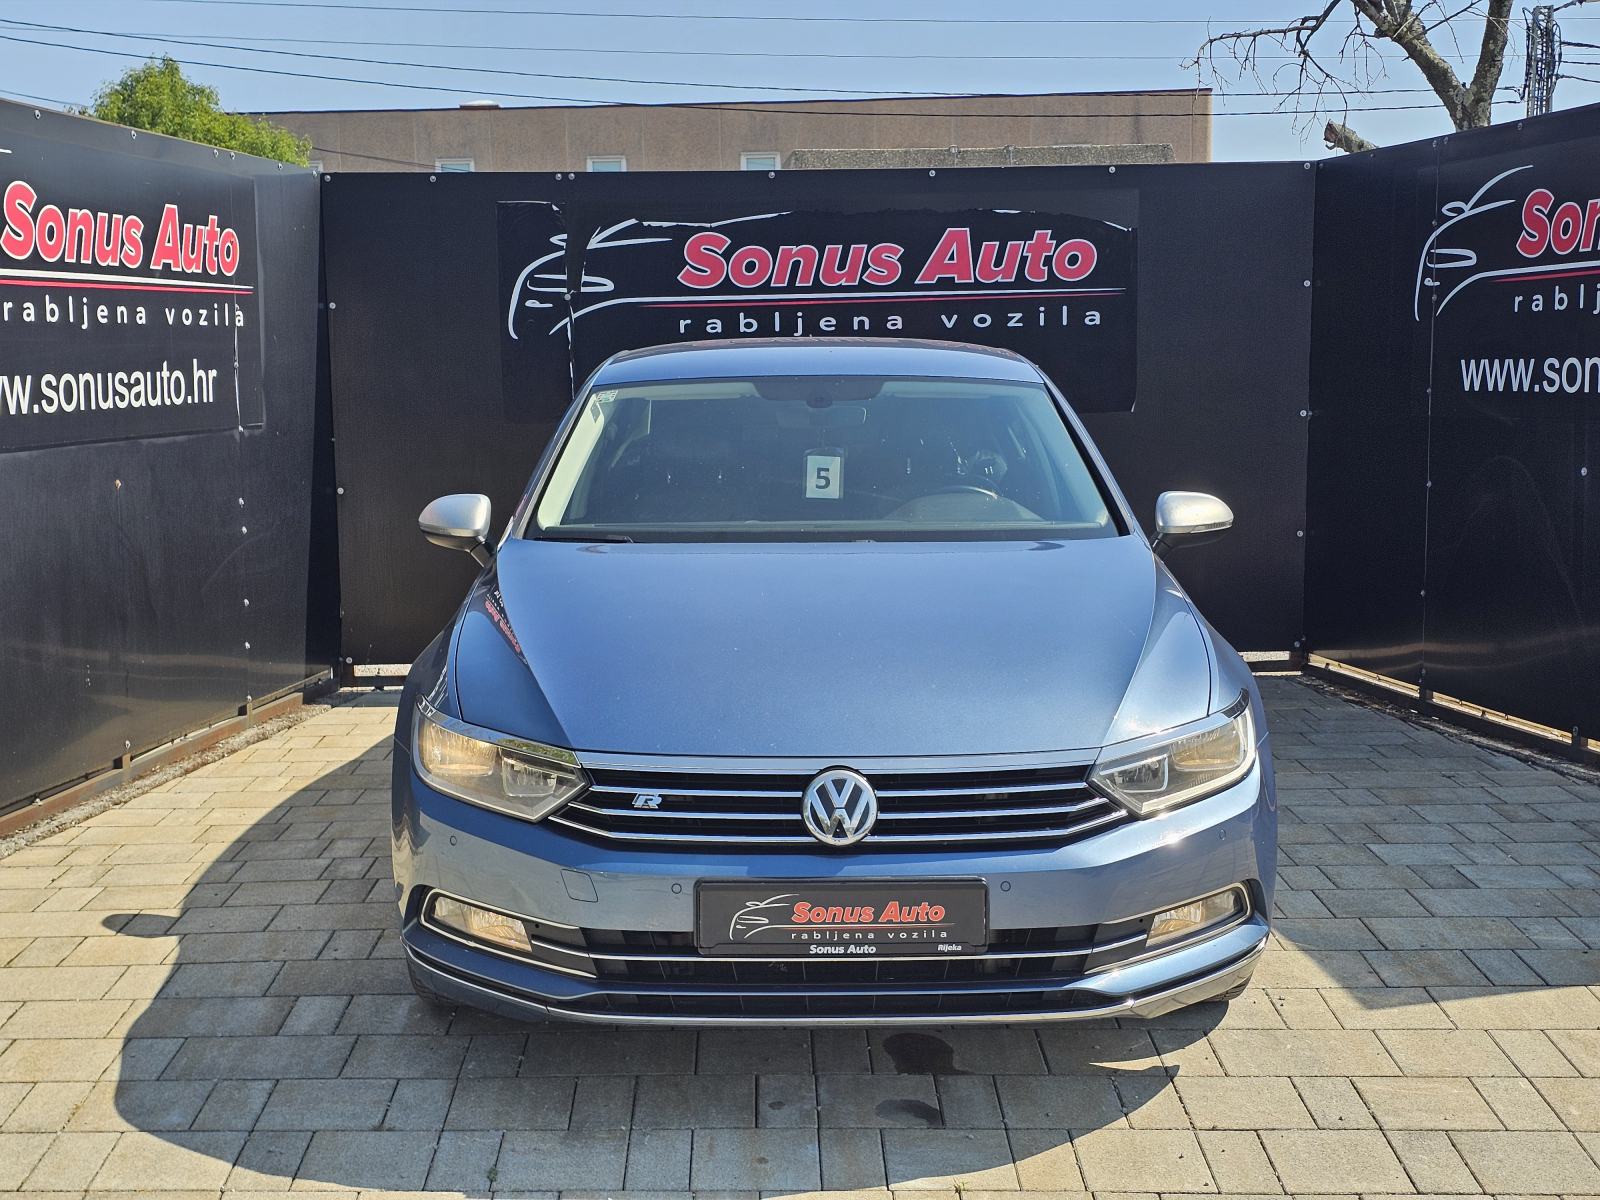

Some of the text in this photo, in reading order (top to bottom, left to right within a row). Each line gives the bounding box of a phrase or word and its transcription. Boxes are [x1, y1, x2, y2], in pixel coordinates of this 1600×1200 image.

[0, 180, 240, 276] Sonus Auto
[677, 227, 1097, 289] Sonus Auto
[3, 295, 244, 330] rabljena vozila
[679, 305, 1101, 337] rabljena vozila
[0, 358, 218, 415] w.sonusauto.hr
[816, 467, 831, 490] 5
[791, 900, 946, 923] Sonus Auto
[791, 929, 947, 941] rabljena vozila
[937, 944, 962, 952] Rijeka
[809, 944, 877, 954] Sonus Auto
